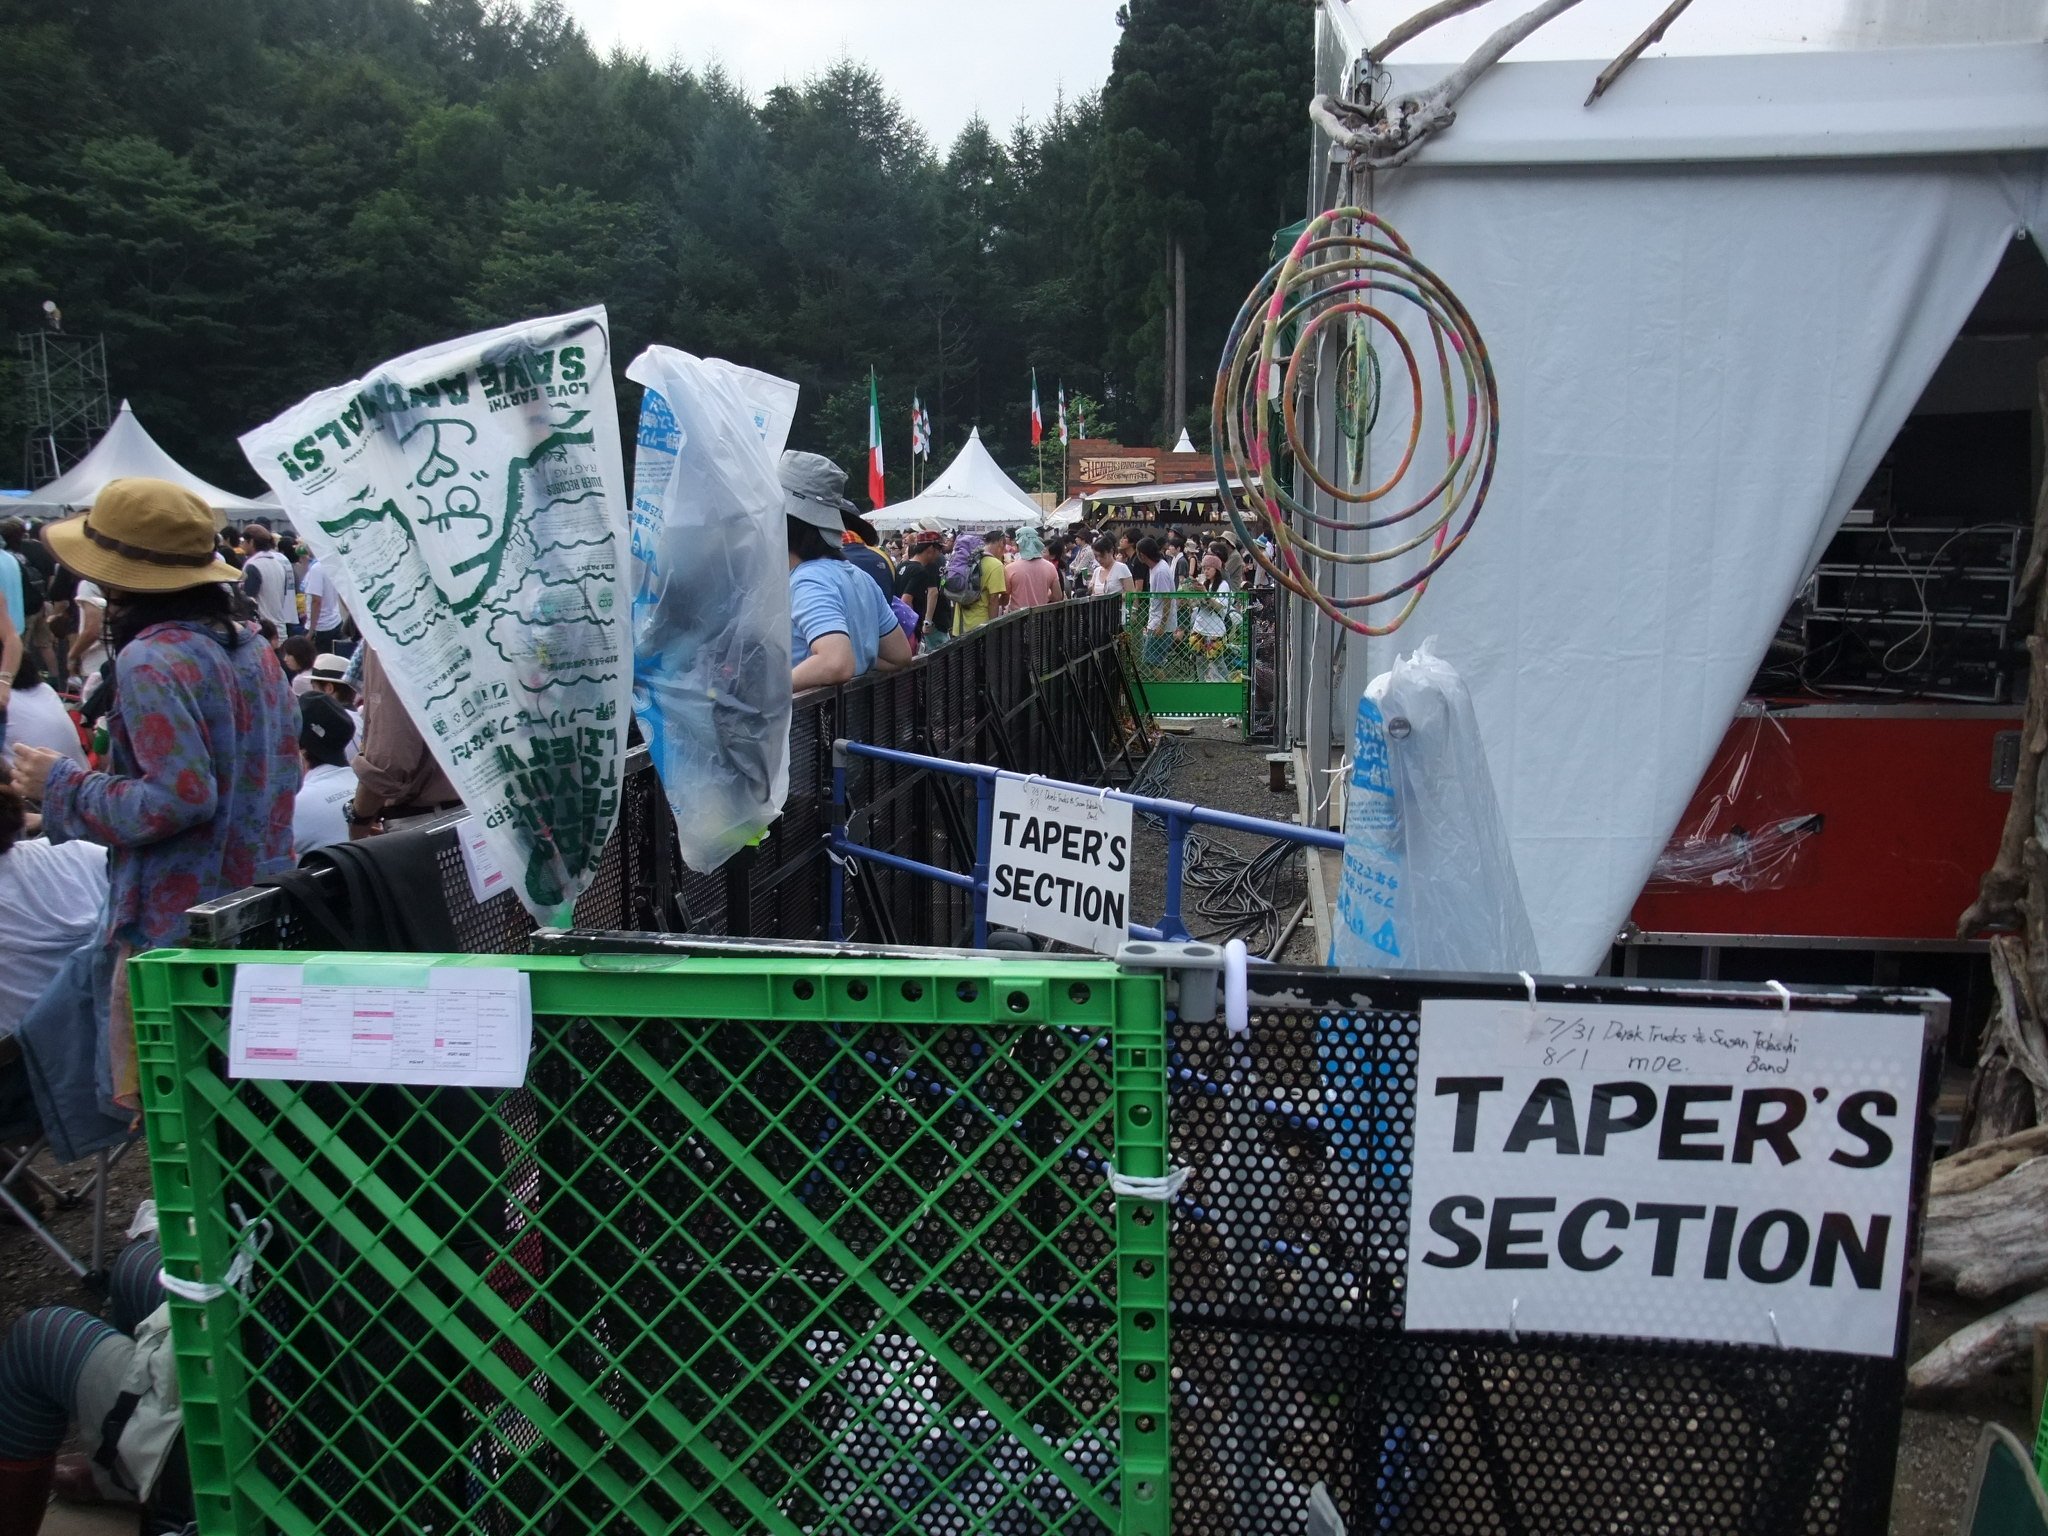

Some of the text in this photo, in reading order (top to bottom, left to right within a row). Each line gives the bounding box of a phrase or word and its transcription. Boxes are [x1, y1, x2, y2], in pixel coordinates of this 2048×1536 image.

[478, 346, 586, 398] SAVE
[489, 382, 590, 413] LOVE EARTH!
[552, 463, 597, 478] RAGTAG
[999, 811, 1127, 872] TAPER'S
[993, 864, 1125, 929] SECTION
[1544, 1016, 1596, 1042] 7/31
[1709, 1029, 1749, 1050] Susan
[1542, 1047, 1589, 1071] 8/1
[1746, 1054, 1790, 1075] Band
[1434, 1075, 1898, 1169] TAPER'S
[1421, 1195, 1892, 1290] SECTION
